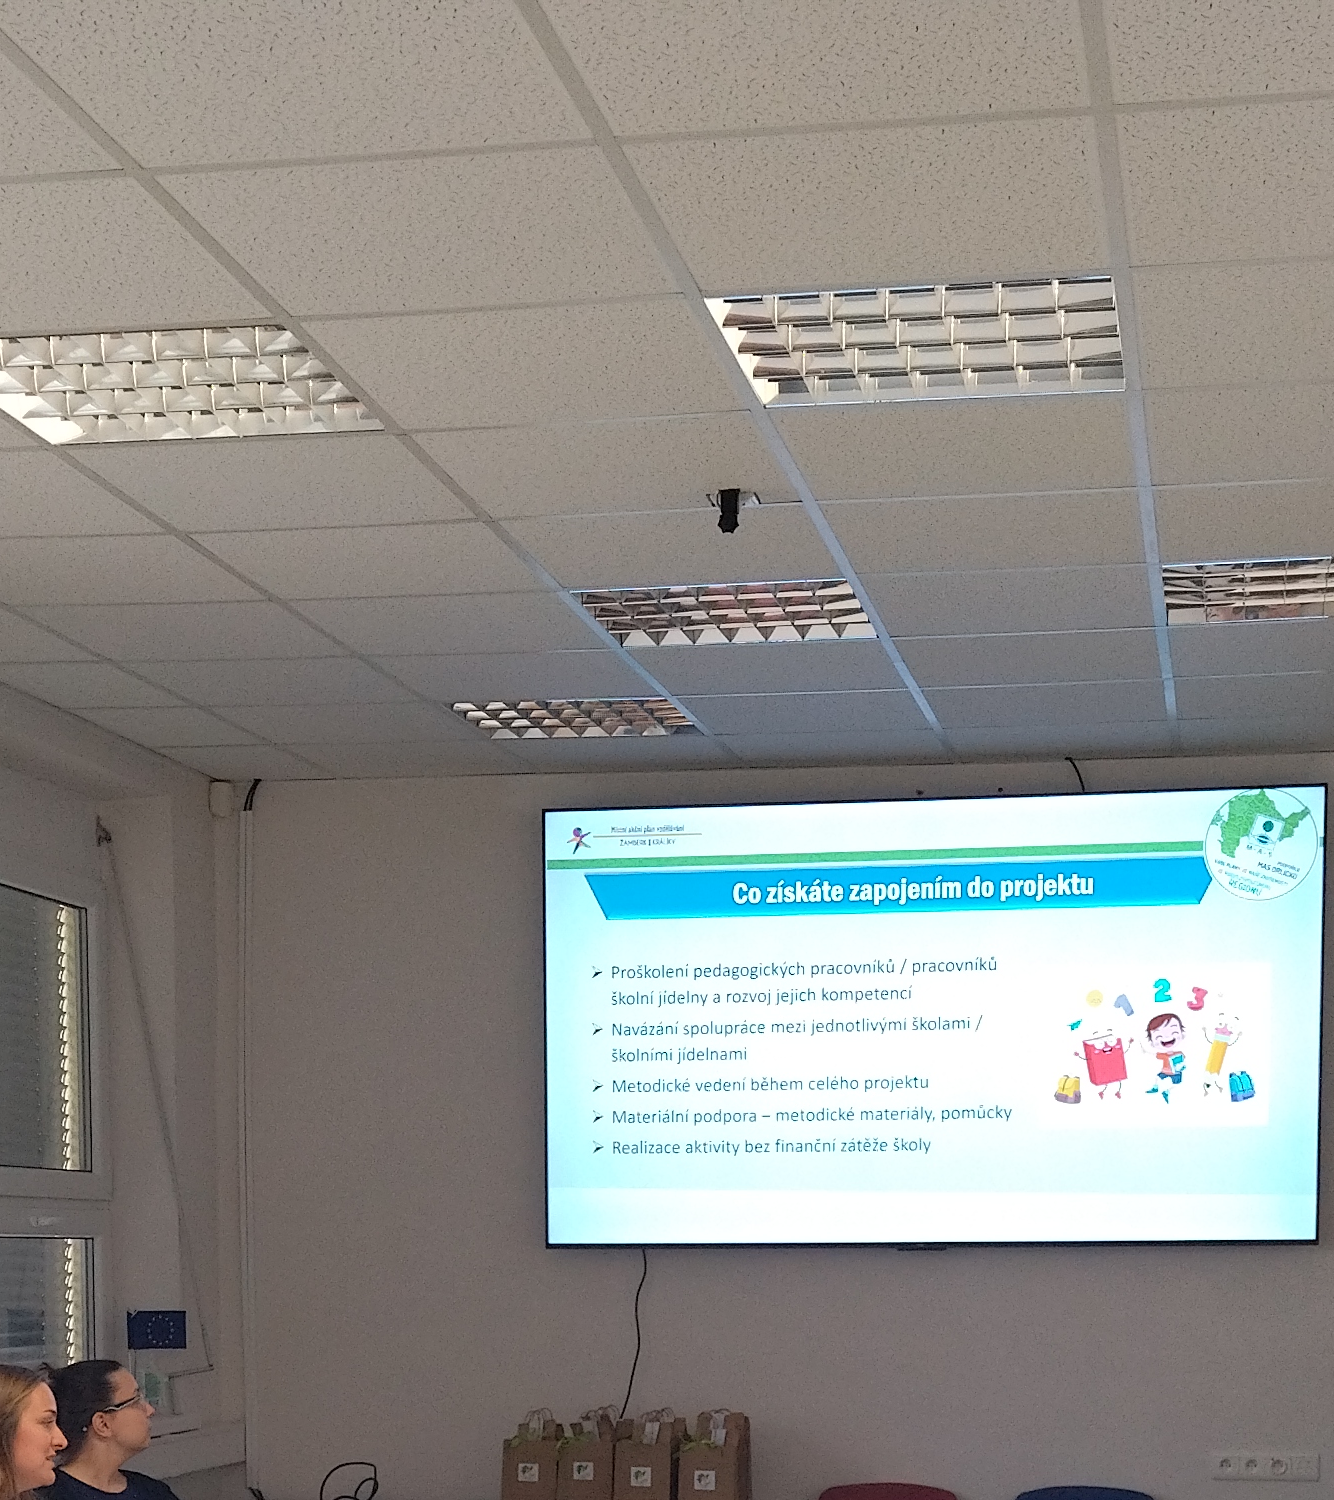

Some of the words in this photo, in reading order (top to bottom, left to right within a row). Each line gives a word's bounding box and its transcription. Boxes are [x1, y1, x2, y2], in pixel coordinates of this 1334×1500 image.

[732, 882, 761, 904] Co
[766, 879, 844, 904] získáte
[849, 876, 961, 906] zapojením
[967, 876, 994, 899] do
[1000, 873, 1094, 901] projektu
[612, 964, 688, 979] Proškolení
[694, 961, 804, 980] pedagogických
[811, 959, 894, 978] pracovníků
[900, 959, 907, 974] /
[913, 957, 996, 976] pracovníků
[612, 991, 654, 1005] školní
[658, 990, 708, 1007] jídelny
[713, 994, 720, 1003] a
[727, 989, 770, 1006] rozvoj
[775, 988, 815, 1005] jejich
[822, 985, 912, 1003] kompetencí
[612, 1021, 678, 1036] Navázání
[683, 1020, 765, 1038] spolupráce
[772, 1020, 805, 1033] mezi
[811, 1017, 906, 1036] jednotlivými
[912, 1017, 970, 1030] školami
[975, 1015, 983, 1032] /
[612, 1048, 672, 1062] školními
[677, 1047, 746, 1064] jídelnami
[613, 1078, 690, 1092] Metodické
[695, 1077, 746, 1092] vedení
[751, 1077, 802, 1091] během
[809, 1076, 858, 1090] celého
[865, 1075, 928, 1092] projektu
[613, 1109, 689, 1123] Materiální
[694, 1109, 756, 1126] podpora
[776, 1107, 854, 1121] metodické
[861, 1106, 935, 1123] materiály,
[942, 1105, 1012, 1122] pomůcky
[613, 1140, 680, 1154] Realizace
[686, 1140, 740, 1156] aktivity
[745, 1140, 770, 1153] bez
[775, 1138, 836, 1152] finanční
[841, 1138, 888, 1152] zátěže
[893, 1138, 931, 1154] školy
